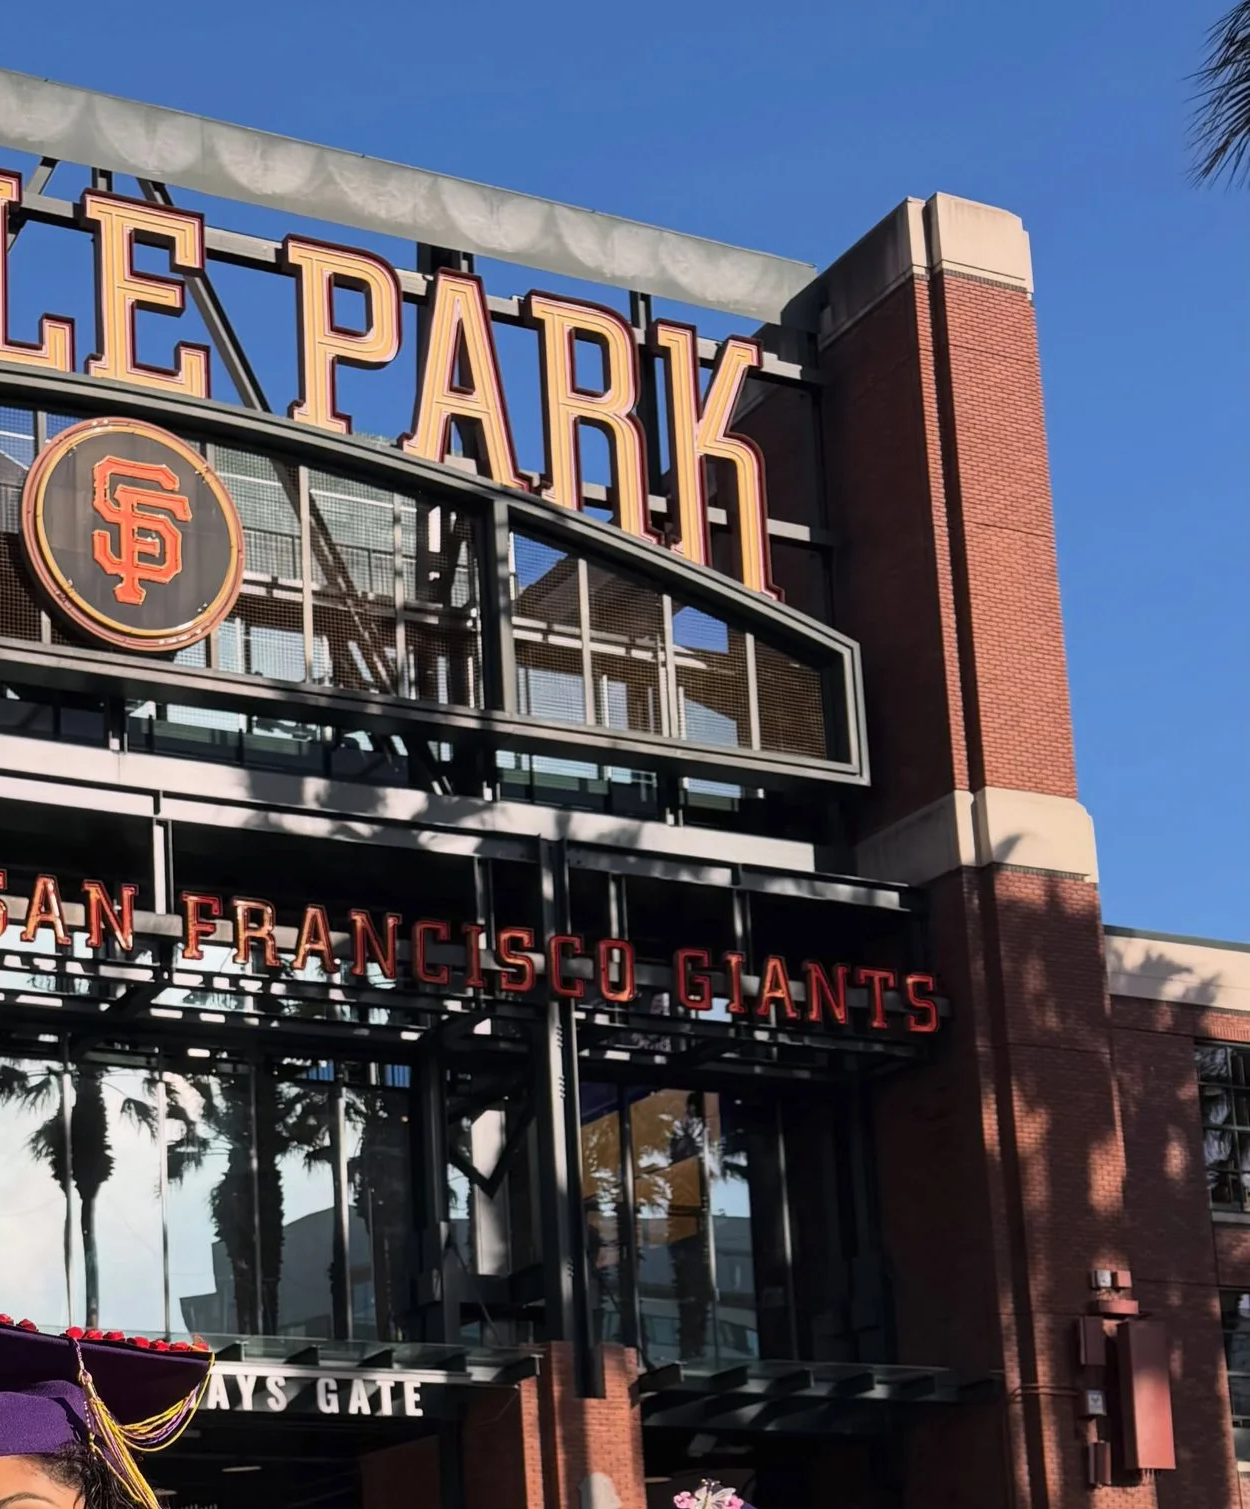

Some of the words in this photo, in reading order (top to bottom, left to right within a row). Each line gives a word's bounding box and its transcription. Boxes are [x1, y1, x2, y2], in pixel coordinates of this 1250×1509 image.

[283, 232, 786, 602] PARK
[180, 890, 636, 1003] FRANCISCO
[672, 946, 941, 1034] GIANTS
[206, 1373, 288, 1412] AYS
[316, 1377, 424, 1417] GATE
